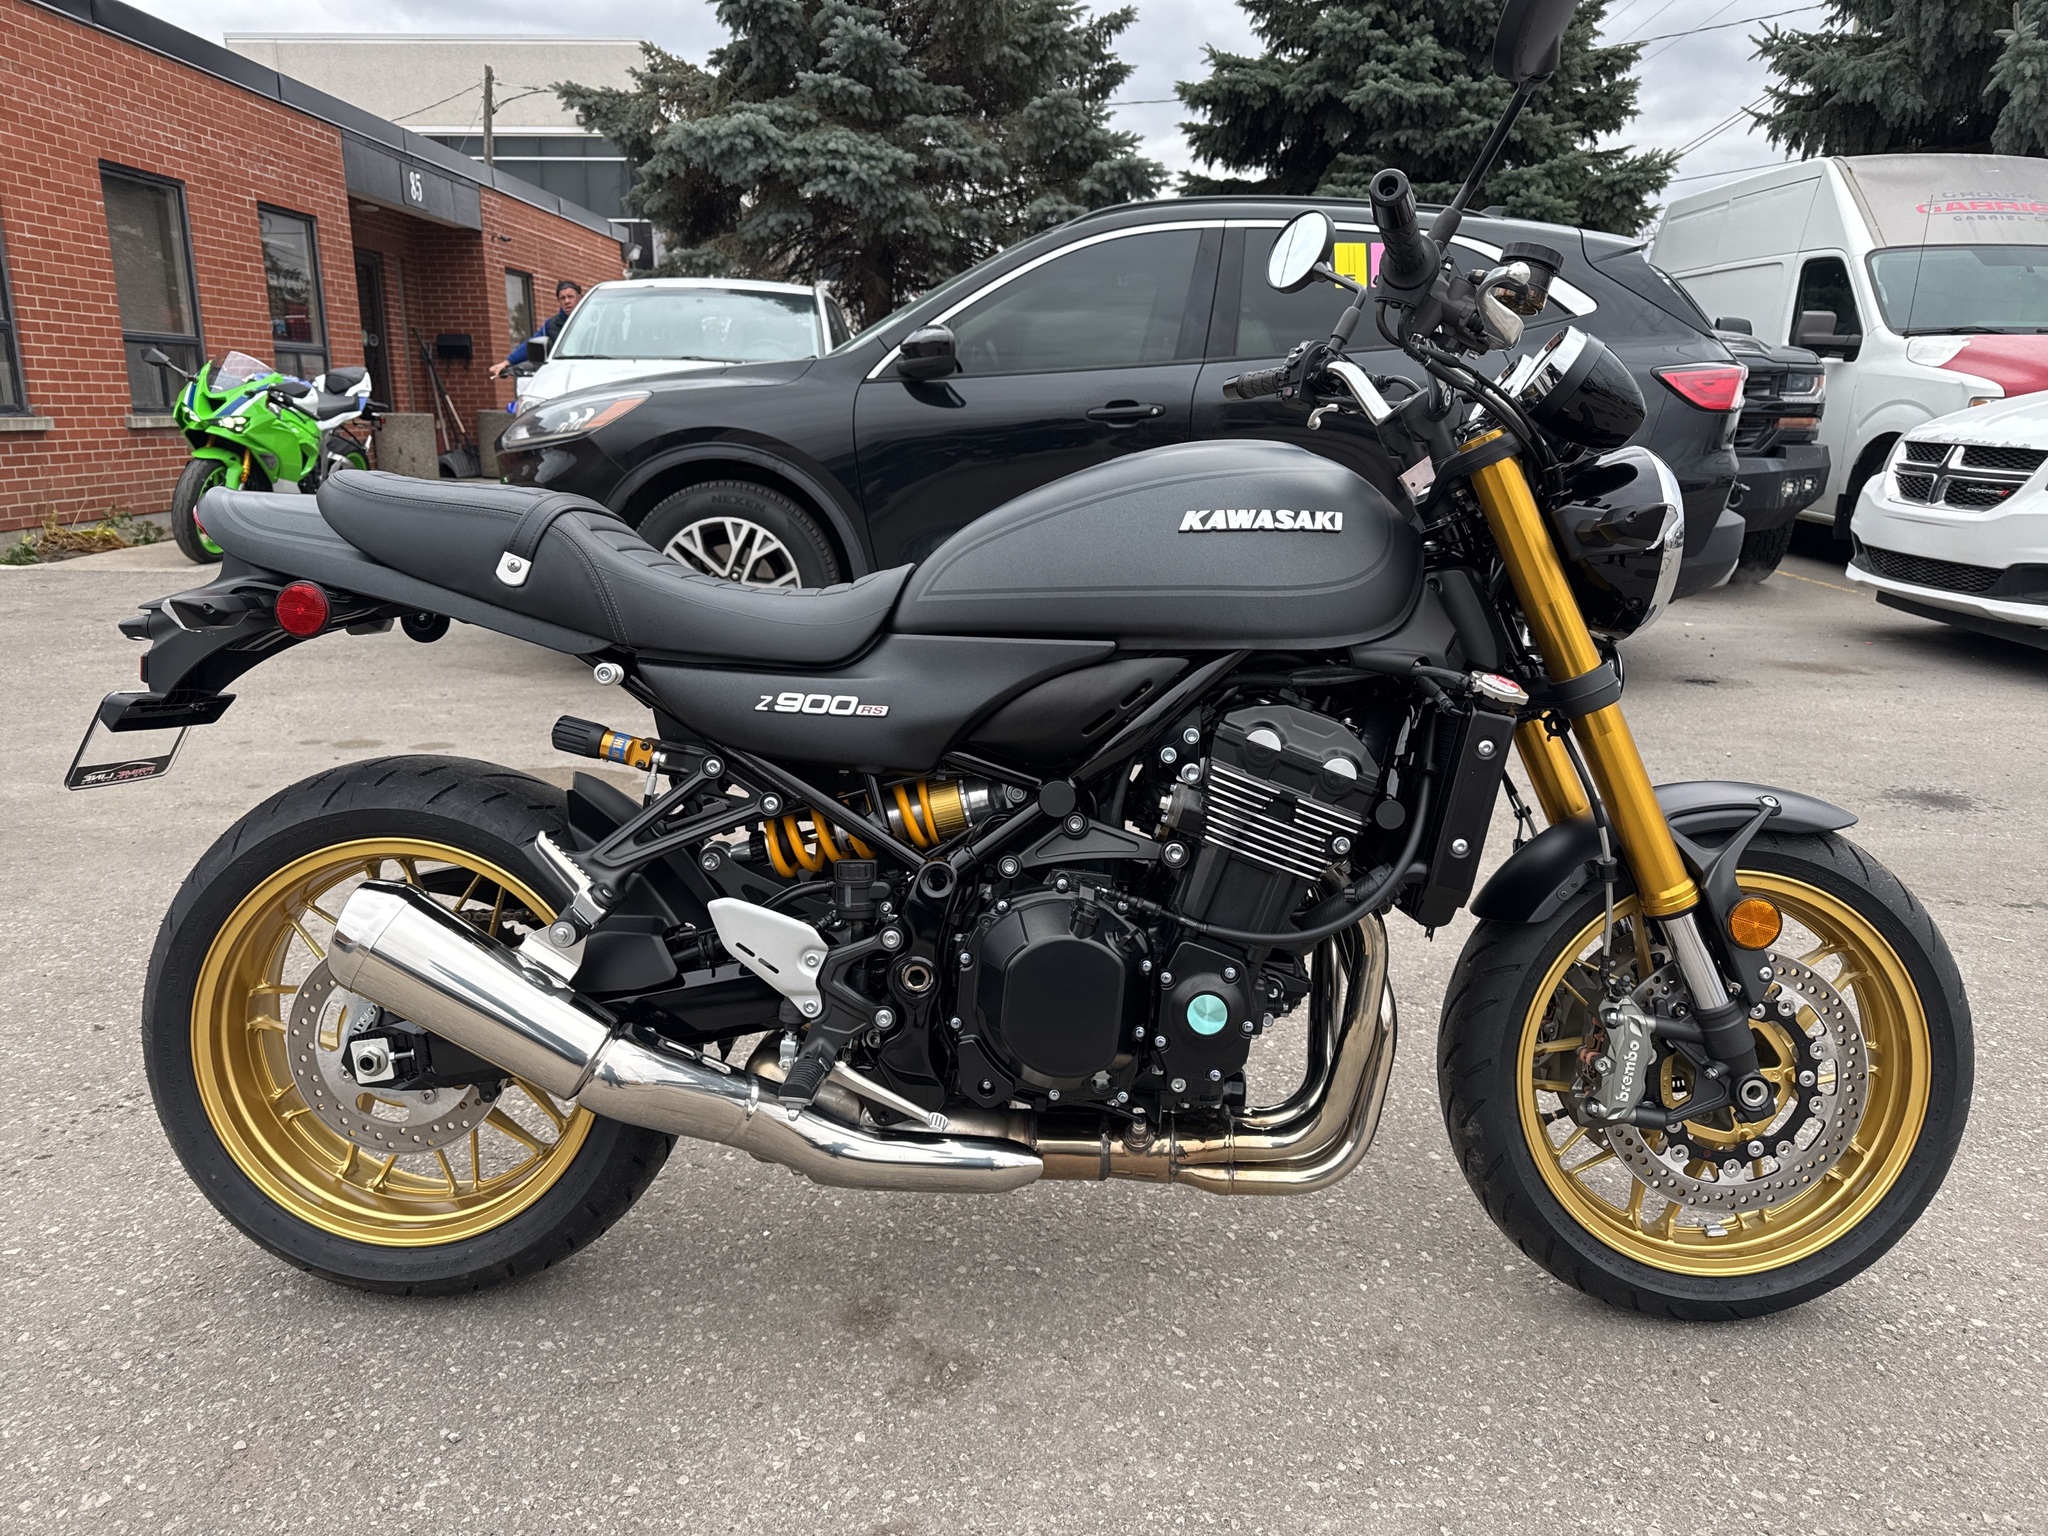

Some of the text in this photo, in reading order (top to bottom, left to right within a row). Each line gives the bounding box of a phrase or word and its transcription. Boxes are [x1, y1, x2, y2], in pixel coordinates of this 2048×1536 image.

[409, 171, 423, 202] 85
[711, 494, 766, 513] NEXEN
[1178, 509, 1344, 533] KAWASAKI
[1615, 1040, 1641, 1103] brembo
